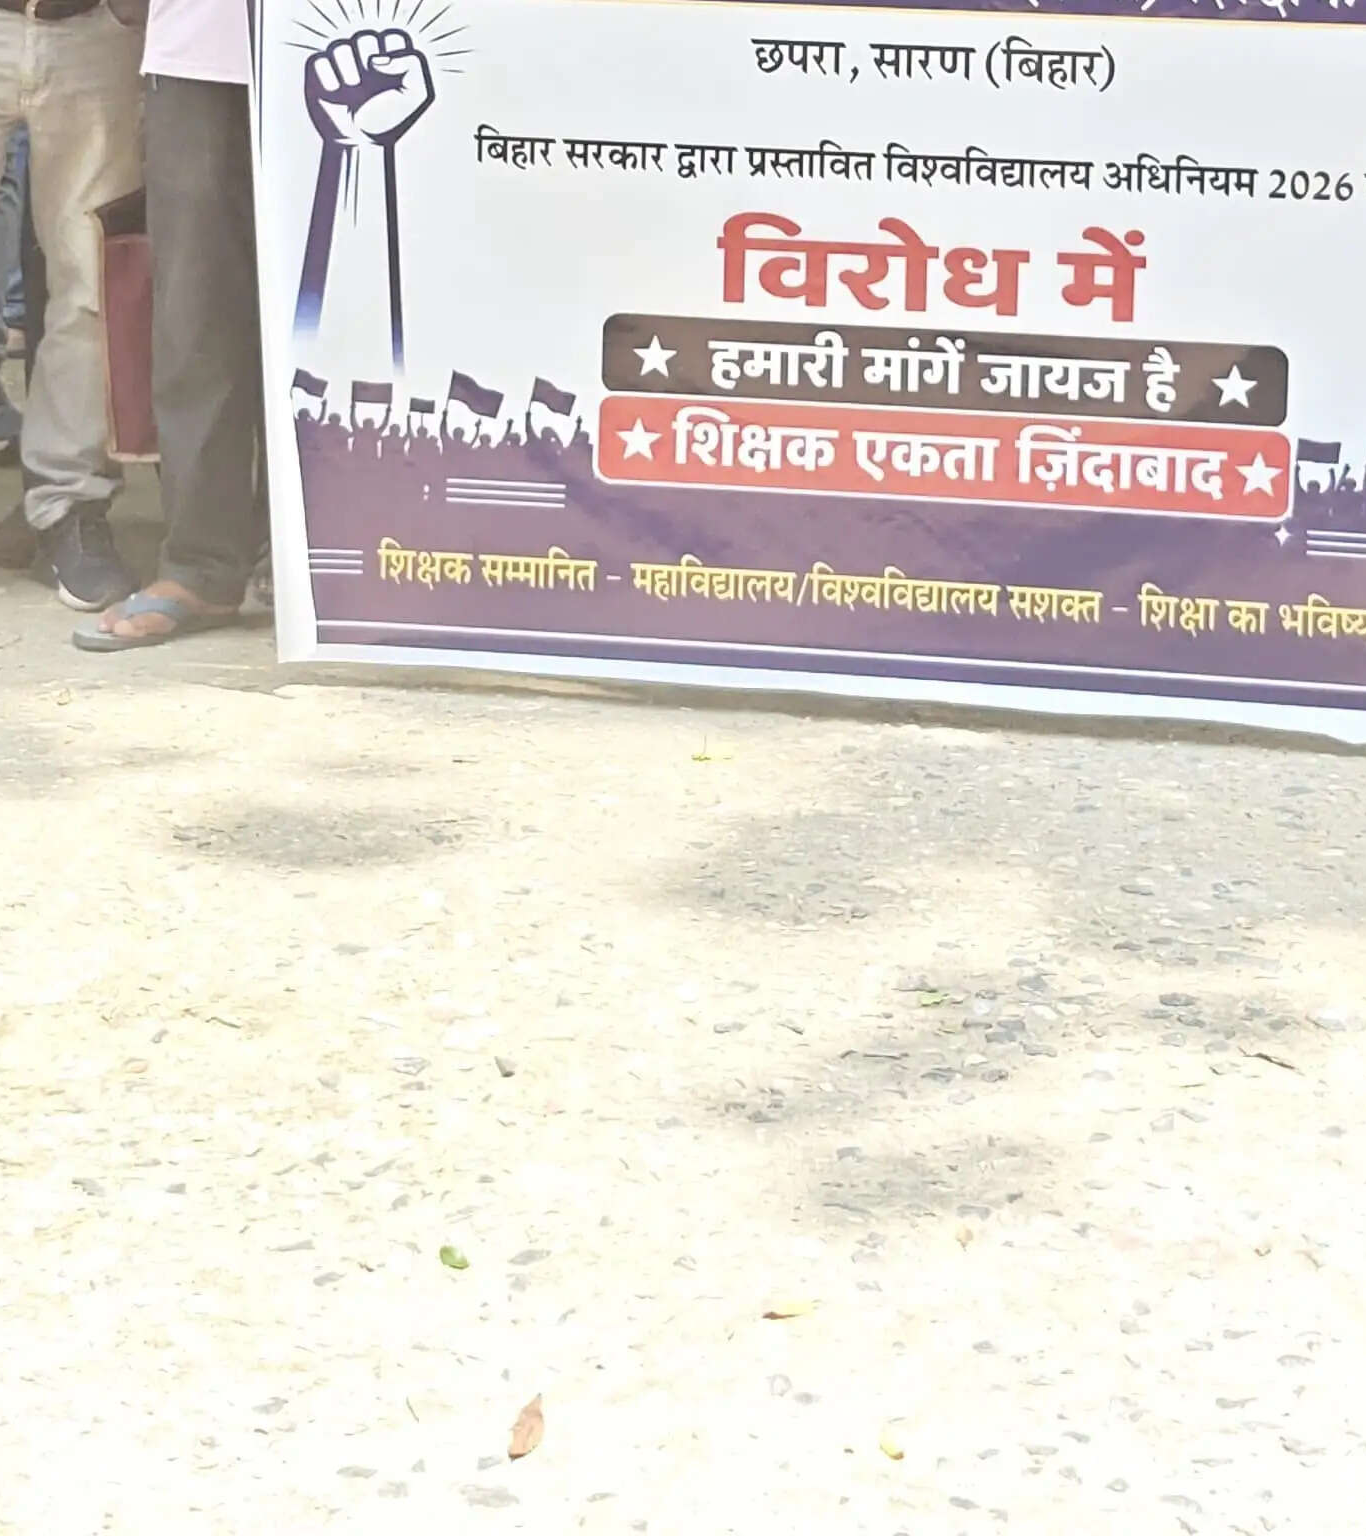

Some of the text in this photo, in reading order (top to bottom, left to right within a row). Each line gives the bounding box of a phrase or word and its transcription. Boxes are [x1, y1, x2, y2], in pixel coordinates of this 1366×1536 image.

[751, 36, 1115, 92] छपरा, सारण (बिहार)
[474, 124, 556, 169] बिहार
[563, 139, 668, 171] सरकार
[674, 144, 738, 178] द्वारा
[745, 140, 876, 180] प्रस्तावित
[883, 143, 1094, 190] विश्वविद्यालय
[1103, 153, 1259, 197] अधिनियम
[1269, 170, 1353, 201] 2026
[718, 212, 1147, 322] विरोध में
[708, 331, 1181, 413] हमारी मांगें जायज है
[671, 407, 1228, 500] शिक्षक एकता ज़िंदाबाद
[378, 537, 473, 589] शिक्षक
[479, 547, 597, 590] सम्मानित
[1007, 586, 1103, 621] सशक्त
[1138, 582, 1217, 633] शिक्षा
[1225, 600, 1269, 632] का
